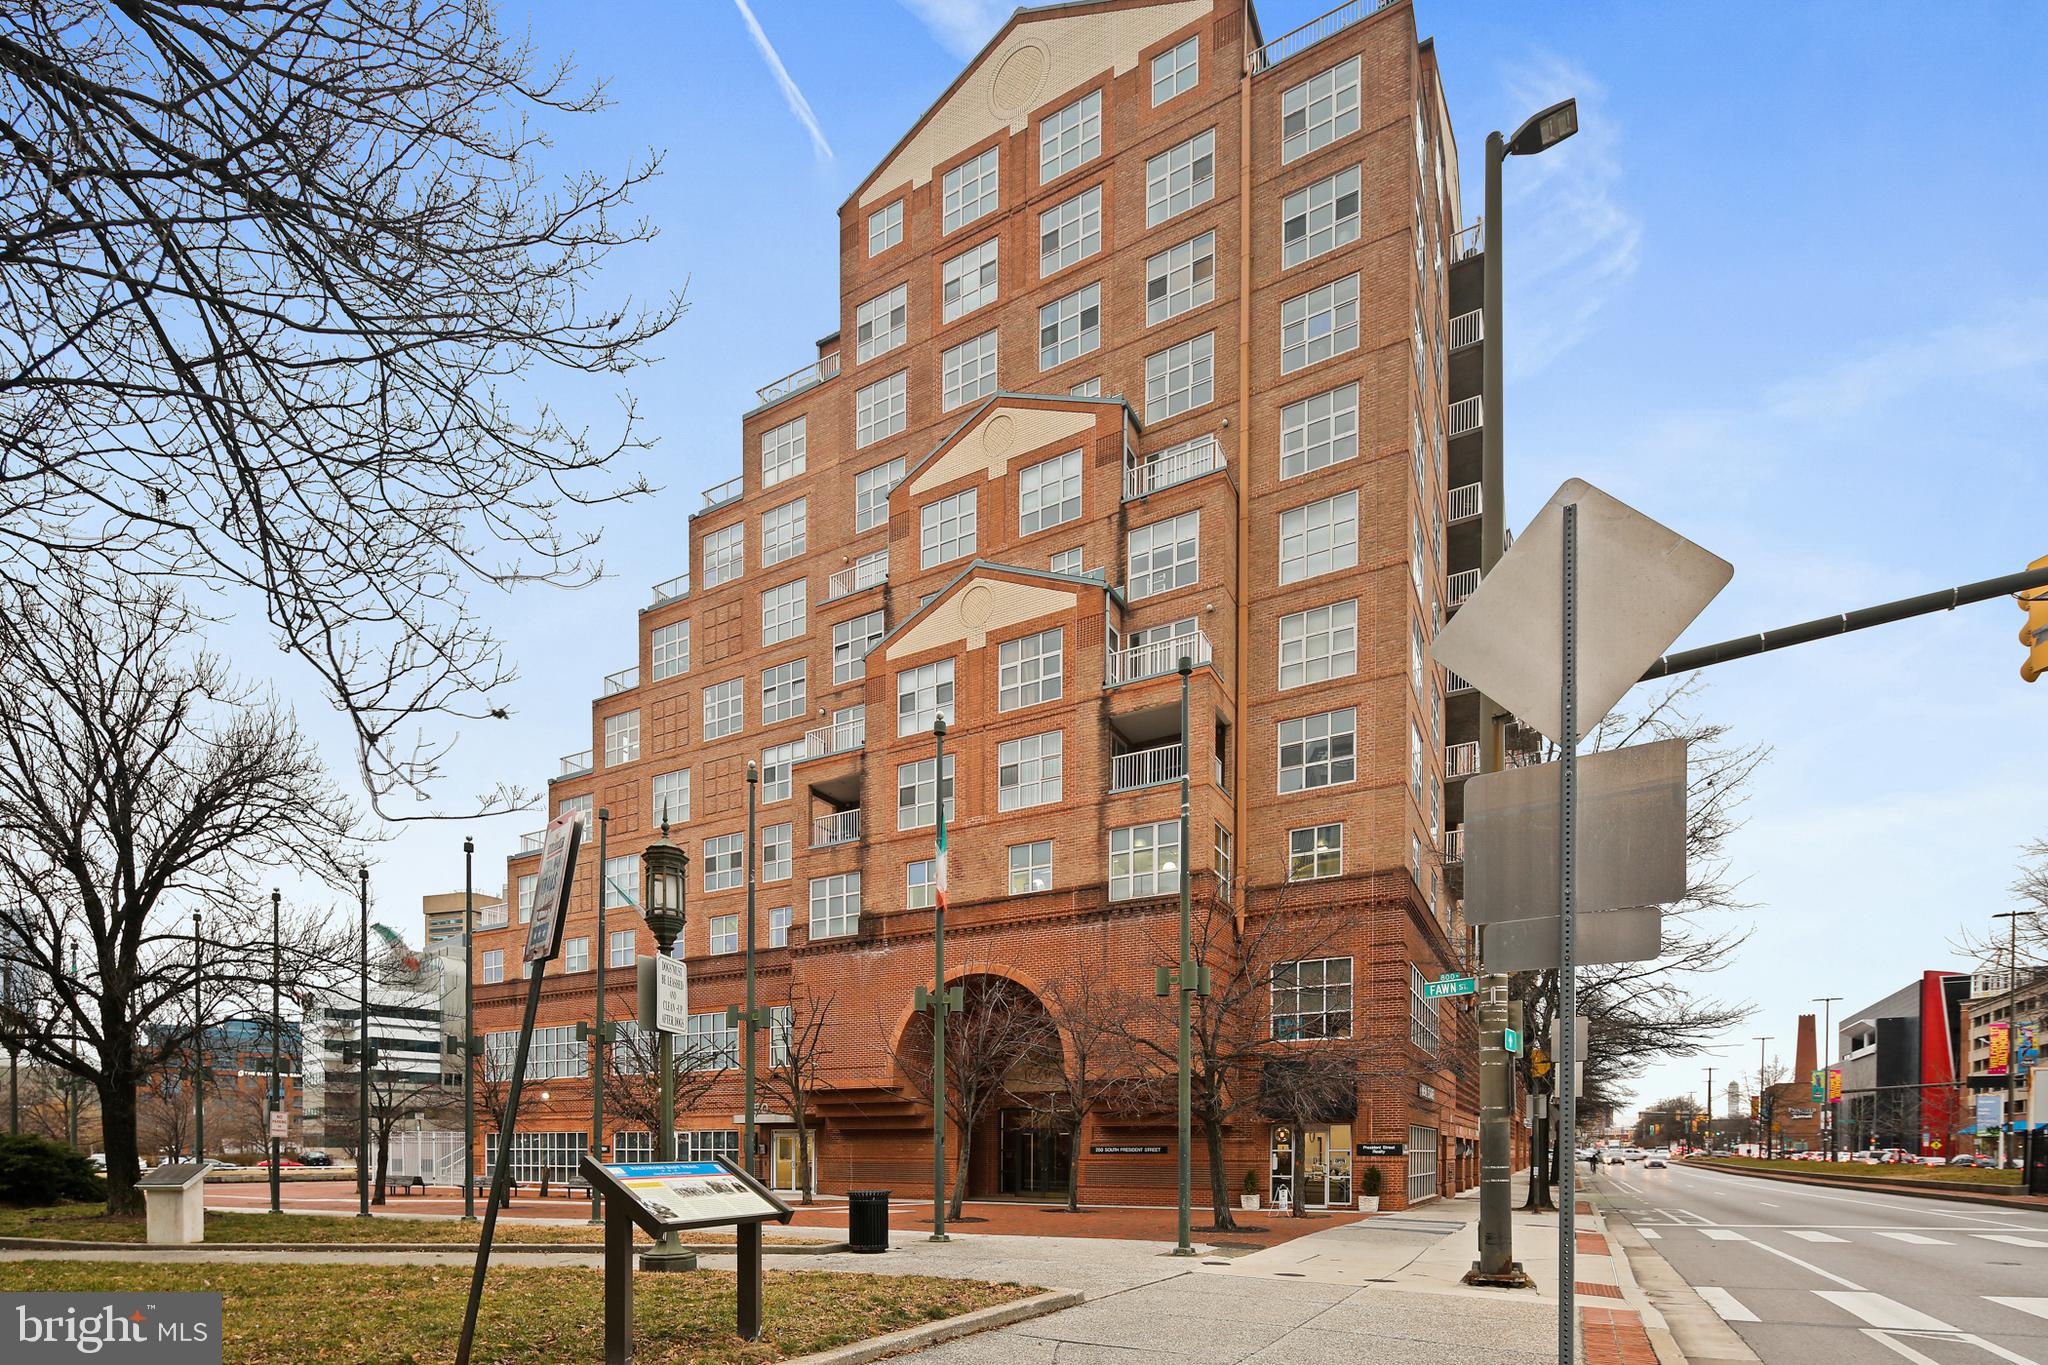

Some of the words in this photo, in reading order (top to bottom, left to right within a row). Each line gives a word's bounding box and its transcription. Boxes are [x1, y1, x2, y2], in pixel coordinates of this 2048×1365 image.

[661, 961, 672, 973] DOGS
[661, 974, 666, 985] BE
[667, 975, 684, 990] LEASHED
[1440, 973, 1455, 981] 800
[1430, 983, 1457, 996] FAWN
[662, 1014, 674, 1027] AFTER
[674, 1017, 685, 1029] DOGS
